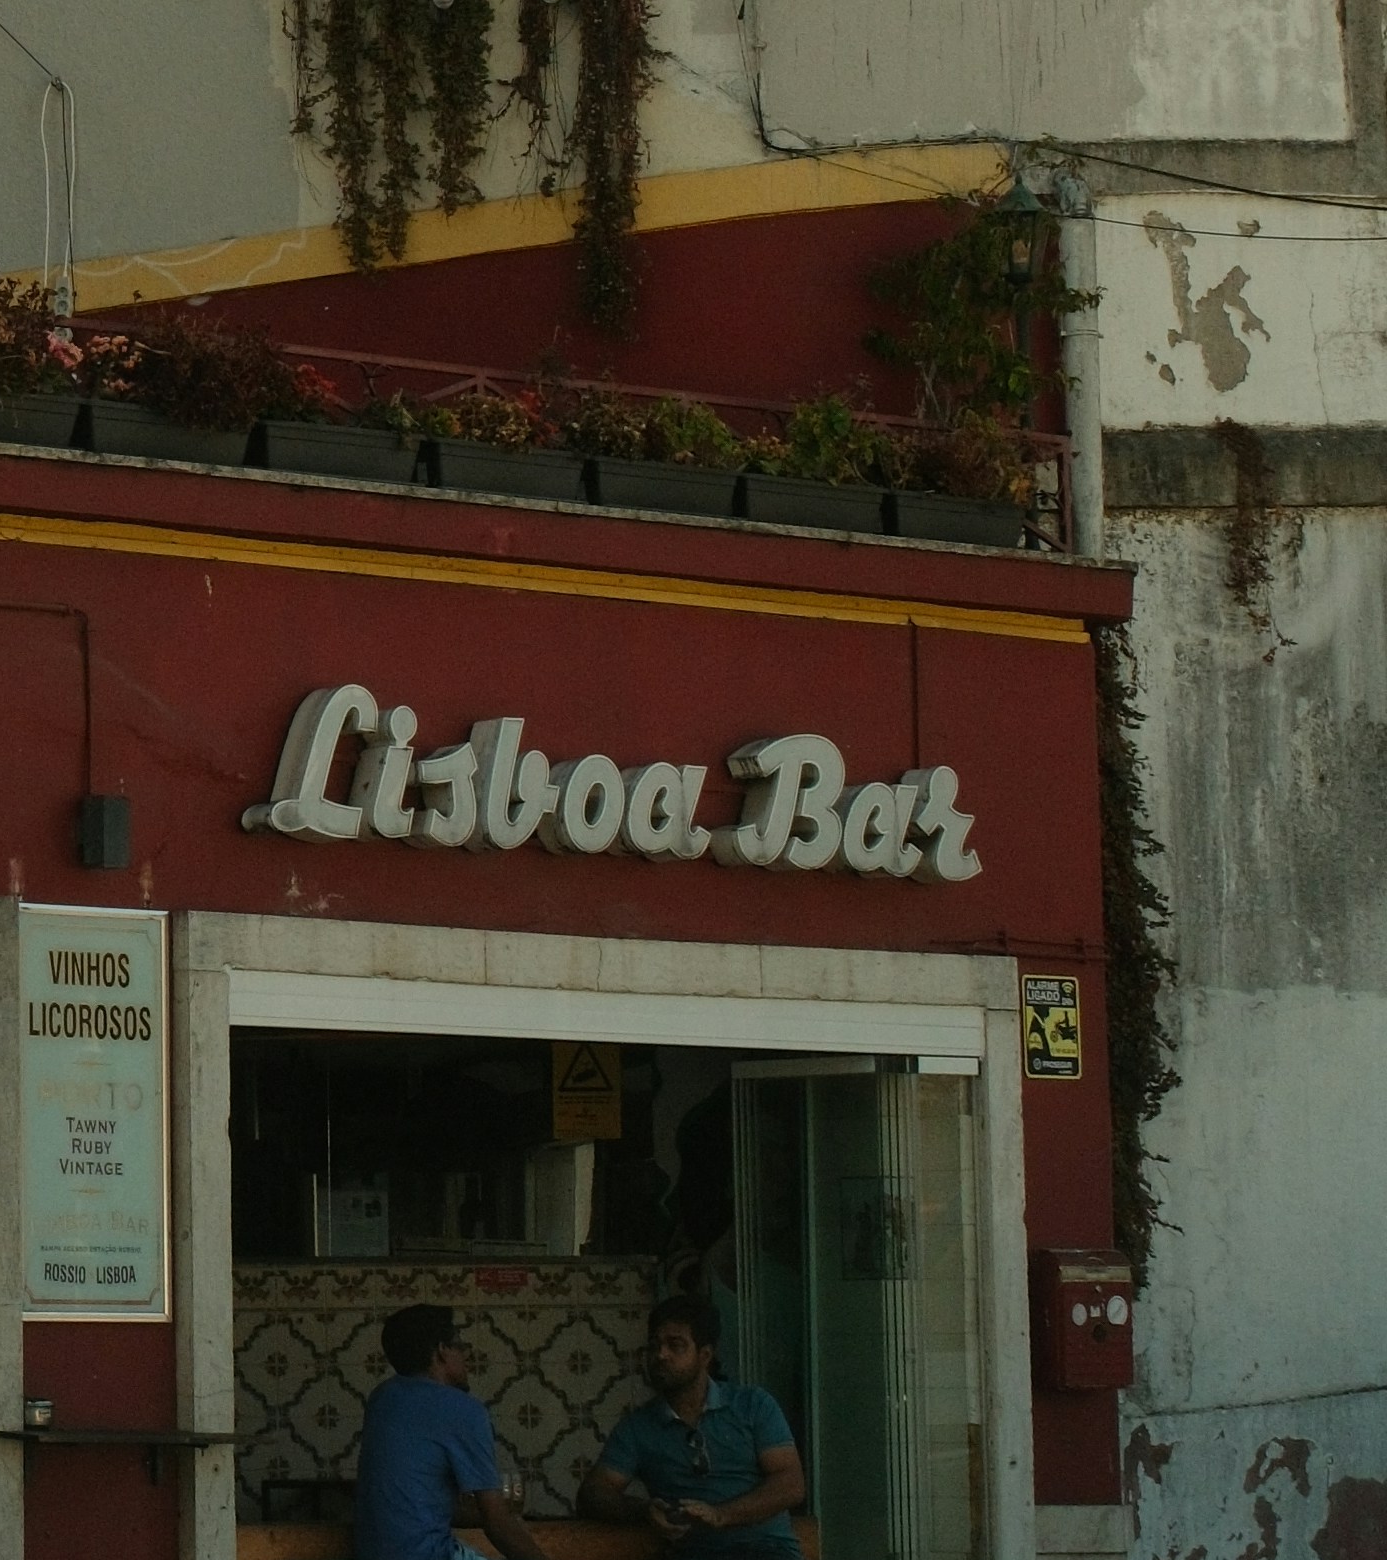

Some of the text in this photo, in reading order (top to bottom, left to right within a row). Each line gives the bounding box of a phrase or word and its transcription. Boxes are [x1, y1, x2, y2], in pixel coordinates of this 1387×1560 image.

[240, 683, 984, 882] Lisboa Bar
[48, 949, 131, 989] VINHOS
[1026, 990, 1061, 1001] LIGADO
[27, 1001, 152, 1043] LICOROSOS
[65, 1116, 117, 1136] TAWNY
[71, 1137, 113, 1156] RUBY
[59, 1158, 124, 1177] VINTAGE
[43, 1262, 137, 1286] ROSSIO LISBOA
